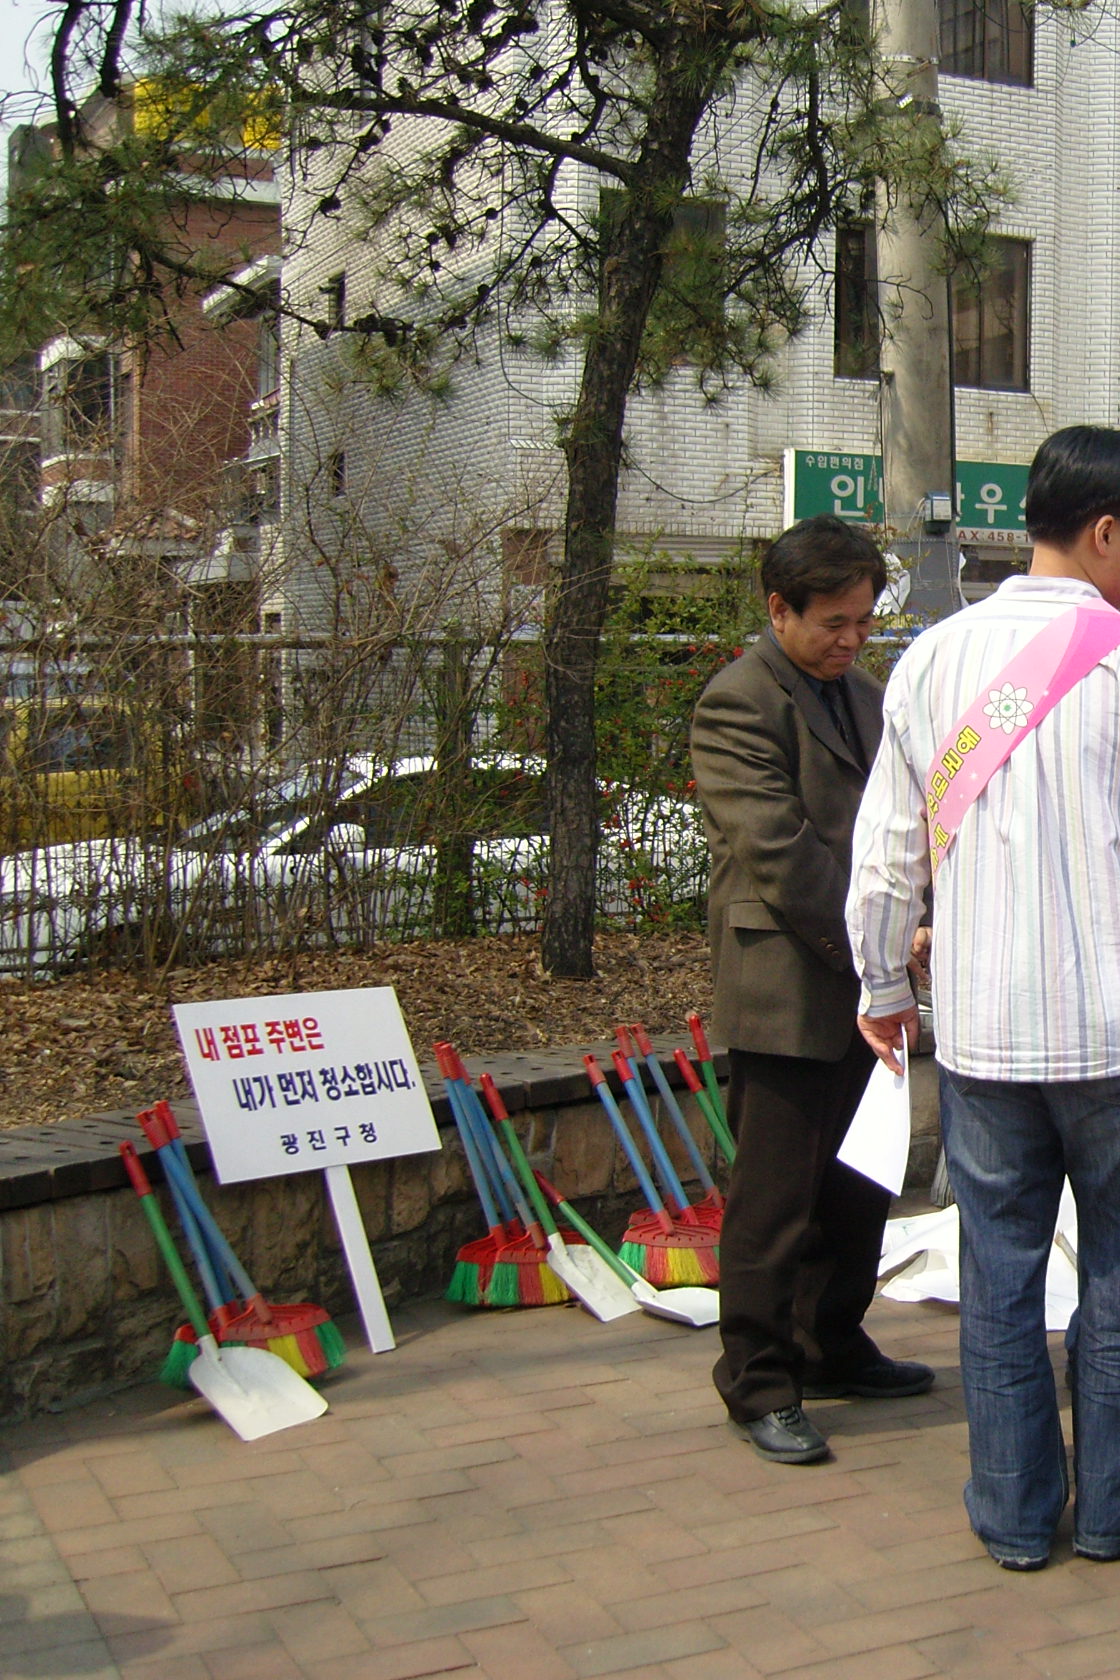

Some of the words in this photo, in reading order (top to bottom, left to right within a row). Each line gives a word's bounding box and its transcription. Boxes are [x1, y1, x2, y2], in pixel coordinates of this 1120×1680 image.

[194, 1027, 221, 1061] 내
[219, 1022, 264, 1060] 점포
[264, 1016, 325, 1054] 주변은
[233, 1073, 277, 1111] 내가
[276, 1069, 319, 1106] 먼저
[318, 1058, 416, 1101] 청소합시다.
[280, 1122, 378, 1155] 광진구청
